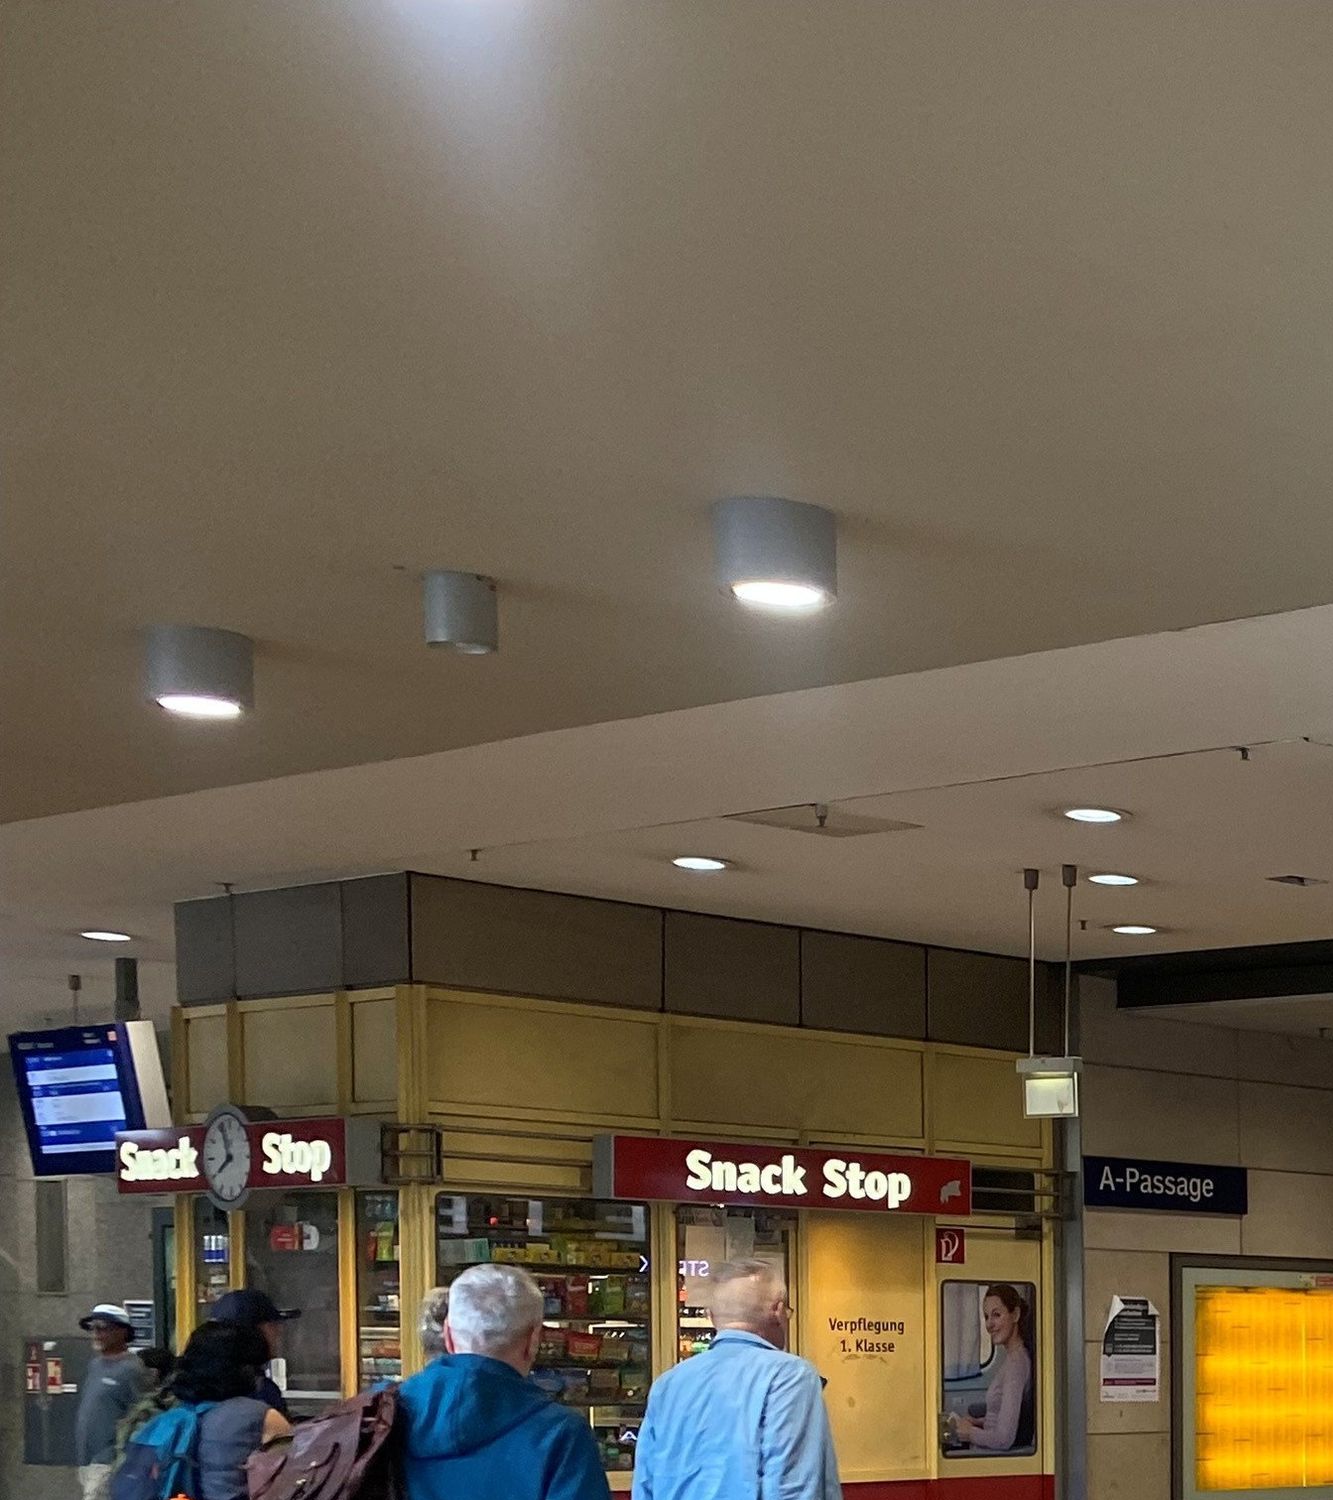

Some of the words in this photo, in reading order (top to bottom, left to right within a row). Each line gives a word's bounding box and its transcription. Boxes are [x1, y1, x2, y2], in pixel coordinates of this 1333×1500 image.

[120, 1136, 199, 1181] Snack
[262, 1132, 331, 1182] Stop
[686, 1149, 808, 1196] Snack
[823, 1158, 912, 1209] Stop
[1099, 1165, 1215, 1202] A-Passage
[828, 1317, 905, 1335] Verpflegung
[840, 1339, 852, 1352] 1.
[856, 1339, 895, 1352] Klasse
